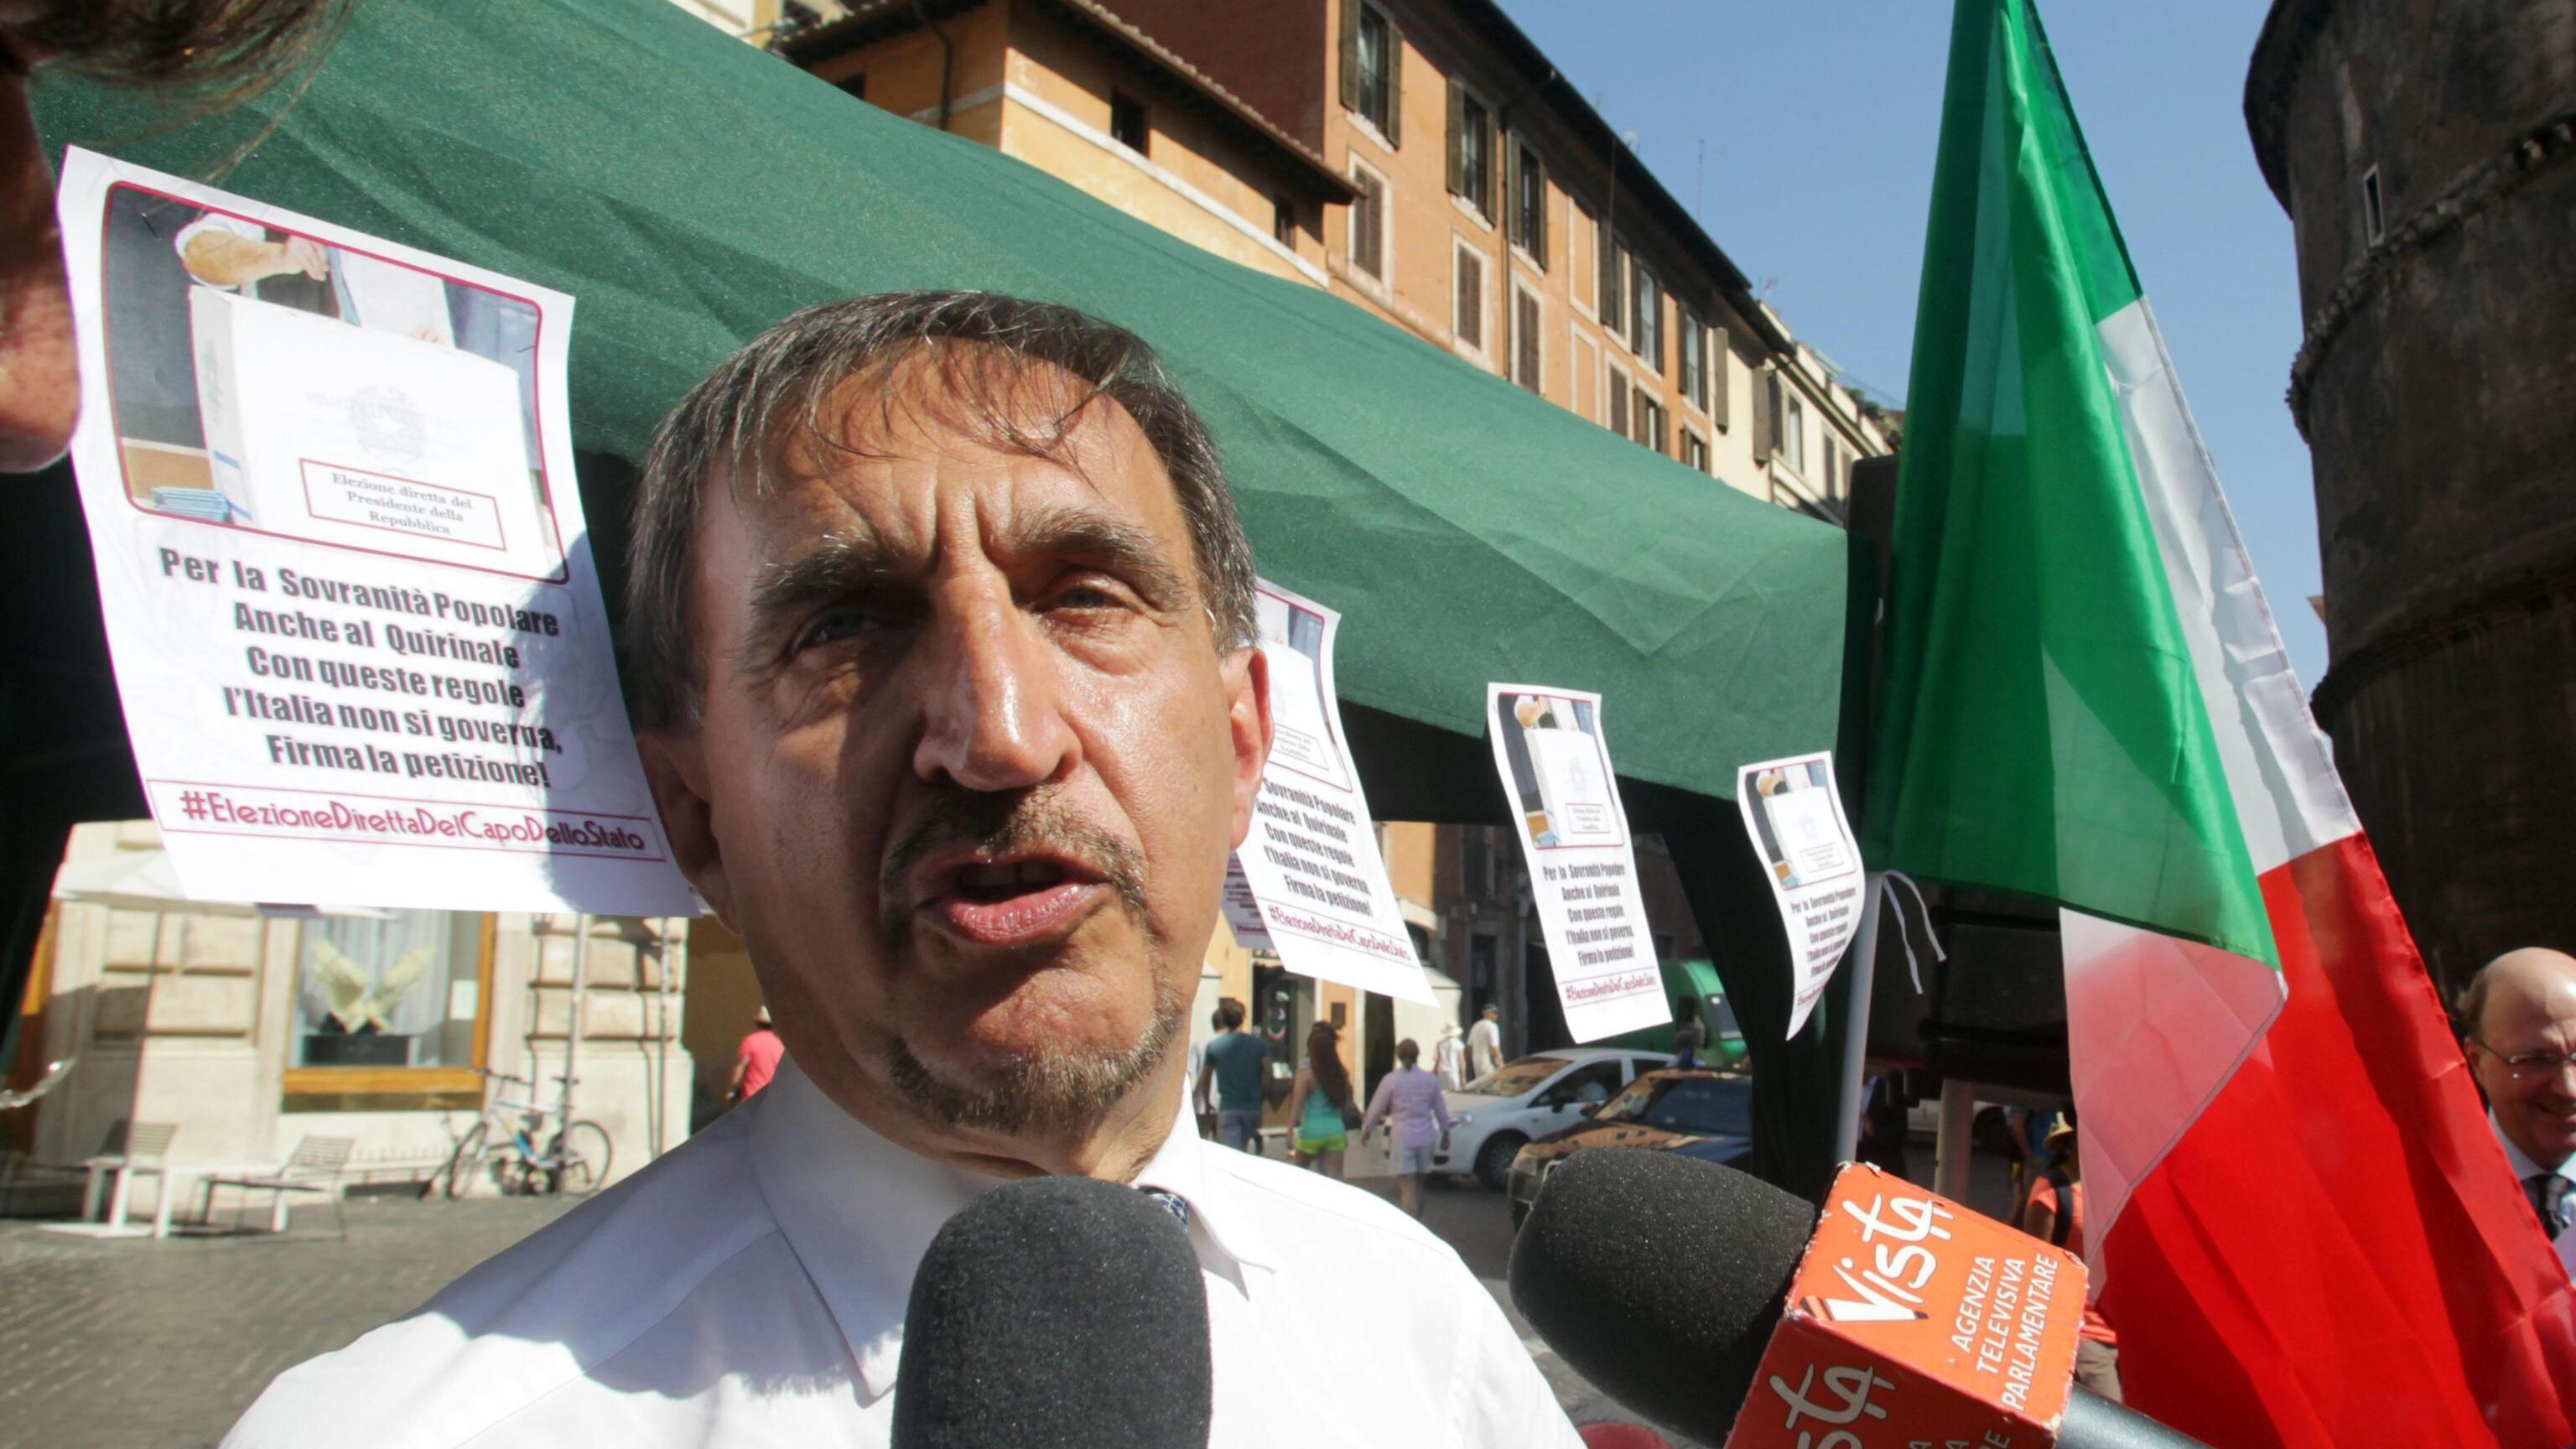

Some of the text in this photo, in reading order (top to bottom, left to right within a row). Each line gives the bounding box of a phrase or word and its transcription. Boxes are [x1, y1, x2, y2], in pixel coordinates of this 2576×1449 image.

[331, 472, 472, 509] Elezione diretta del
[346, 491, 464, 522] Presidente della
[369, 510, 450, 535] Repubblica
[159, 548, 559, 637] Per la Sovranità Popolare
[235, 601, 520, 669] Anche al Quirinale
[247, 645, 525, 709] Con queste regole
[223, 686, 562, 755] l'Italia non si governa,
[266, 734, 550, 788] Firma la petizione!
[179, 790, 645, 850] #ElezioneDirettaDelCapoDelloStato
[1264, 822, 1355, 868] Con queste regole
[1284, 875, 1316, 900] Firma
[1301, 860, 1322, 878] non
[1543, 865, 1557, 881] Per
[1951, 1255, 1996, 1354] AGENZIA
[1976, 1257, 2026, 1375] TELEVISIVA
[2001, 1253, 2059, 1412] PARLAMENTARE
